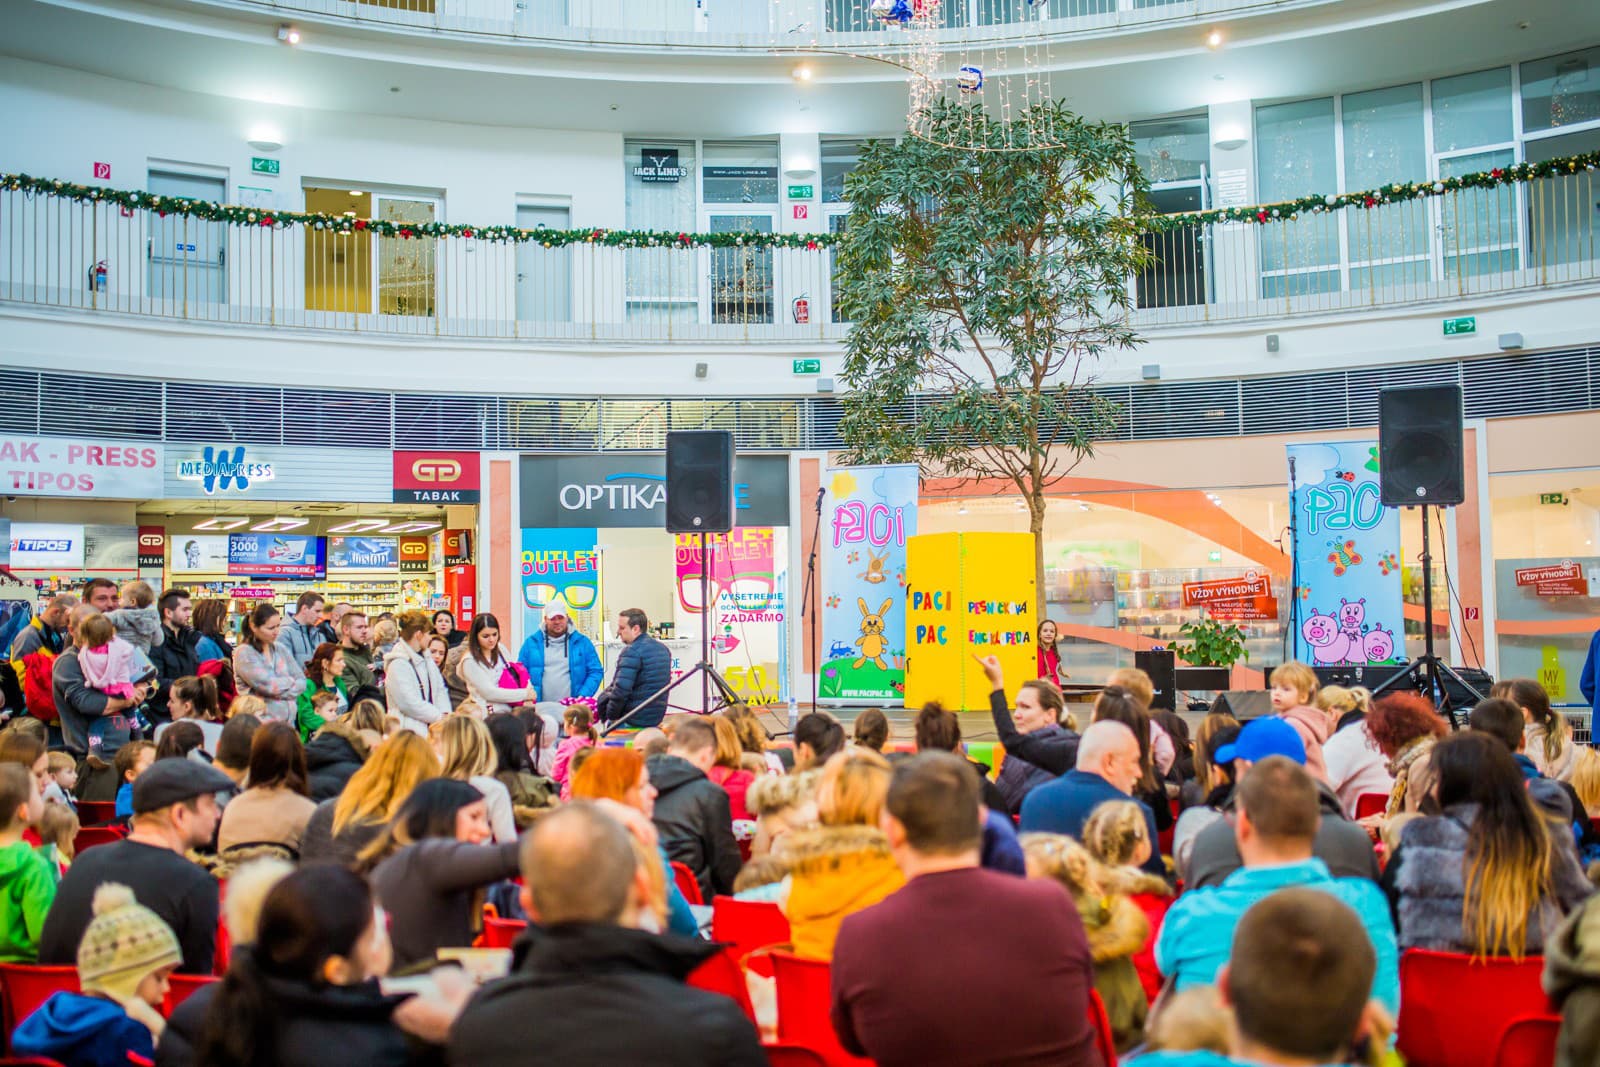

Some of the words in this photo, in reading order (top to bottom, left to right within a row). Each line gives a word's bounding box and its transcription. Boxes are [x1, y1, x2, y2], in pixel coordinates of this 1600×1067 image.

[633, 167, 656, 176] JACK
[657, 167, 687, 176] LINK'S
[67, 445, 157, 468] PRESS
[181, 462, 271, 477] MEDIAPRESS
[8, 471, 94, 491] TIPOS
[413, 492, 460, 501] TABAK
[559, 484, 667, 510] OPTIKA
[22, 541, 69, 550] TIPOS
[230, 542, 258, 552] 3000
[521, 557, 598, 575] OUTLET
[913, 590, 951, 611] PACI
[1191, 588, 1214, 599] VŽDY
[721, 613, 784, 623] ZADARMO
[917, 625, 947, 645] PAC
[1543, 669, 1559, 684] MY
